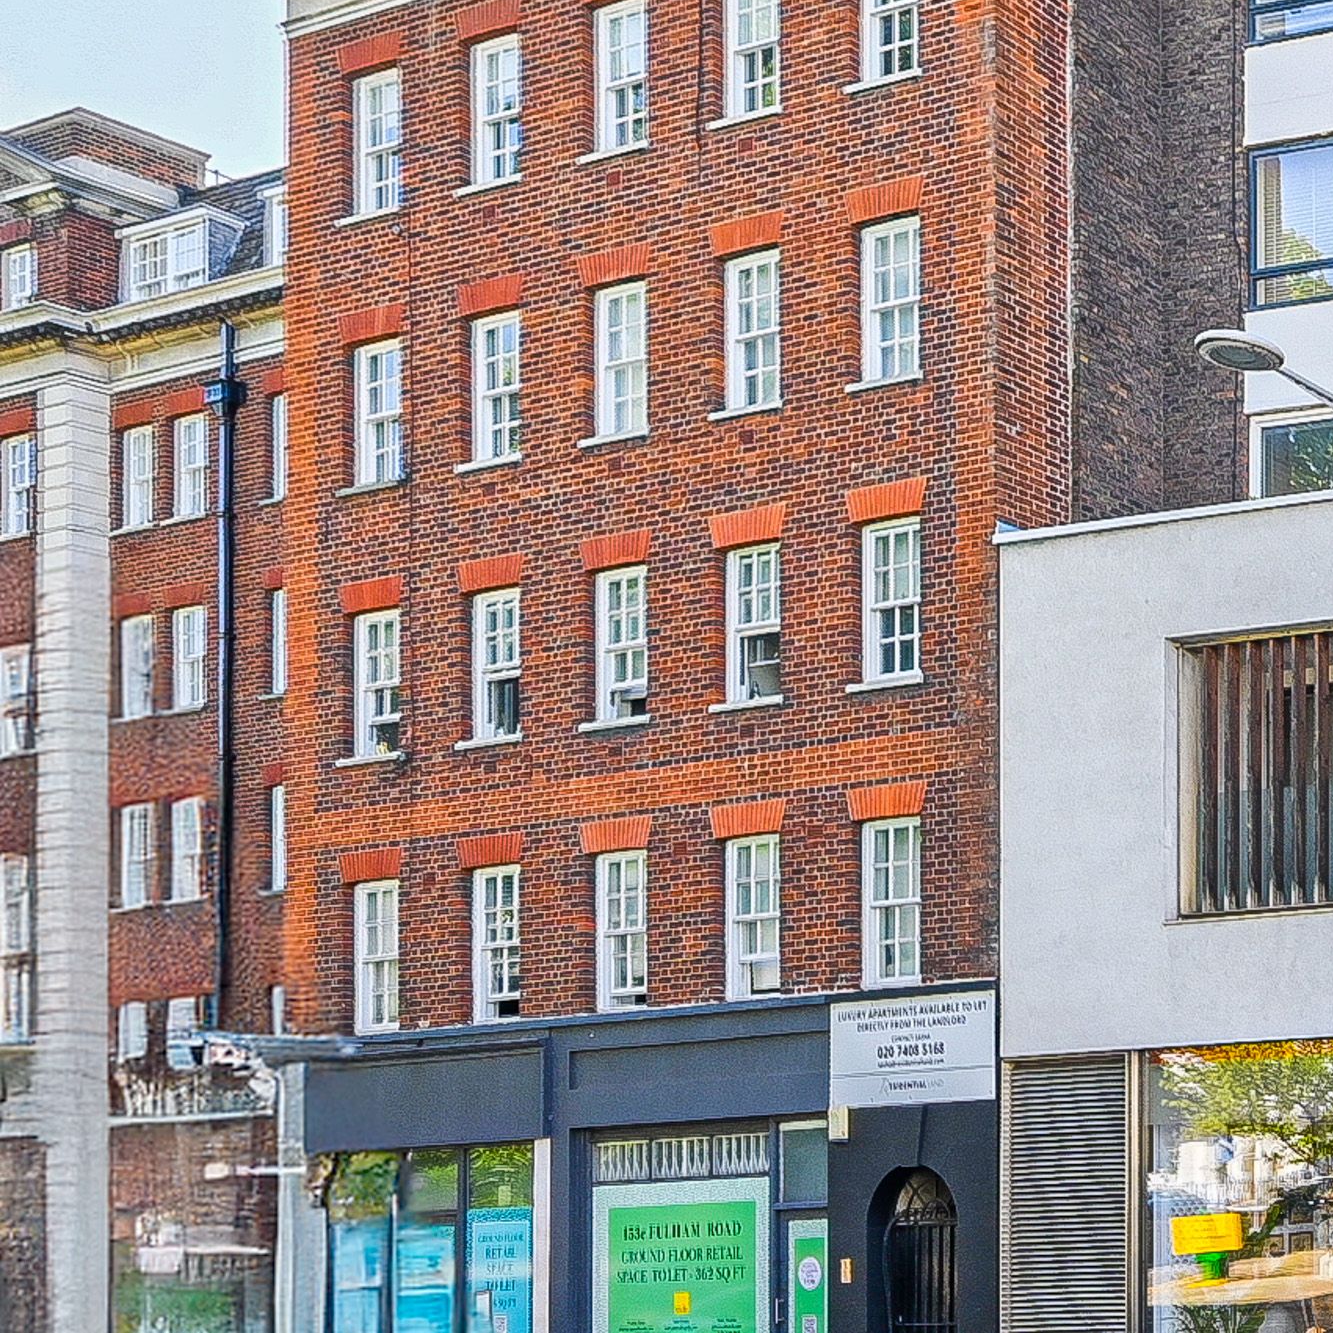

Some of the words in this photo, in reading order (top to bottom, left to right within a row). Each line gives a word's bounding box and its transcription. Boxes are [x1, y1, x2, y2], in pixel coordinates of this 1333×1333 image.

[919, 1001, 960, 1015] AVAILABLE
[913, 1018, 926, 1029] THE
[877, 1045, 895, 1059] 020
[648, 1222, 701, 1240] FULHAM
[707, 1219, 742, 1237] ROAD
[621, 1248, 666, 1265] GROUND
[668, 1247, 703, 1263] FLOOR
[706, 1245, 744, 1261] RETAIL
[616, 1269, 648, 1284] SPACE
[652, 1269, 667, 1283] TO
[667, 1268, 688, 1283] LET
[695, 1267, 714, 1281] 362
[715, 1266, 731, 1284] SQ
[733, 1265, 747, 1281] FT
